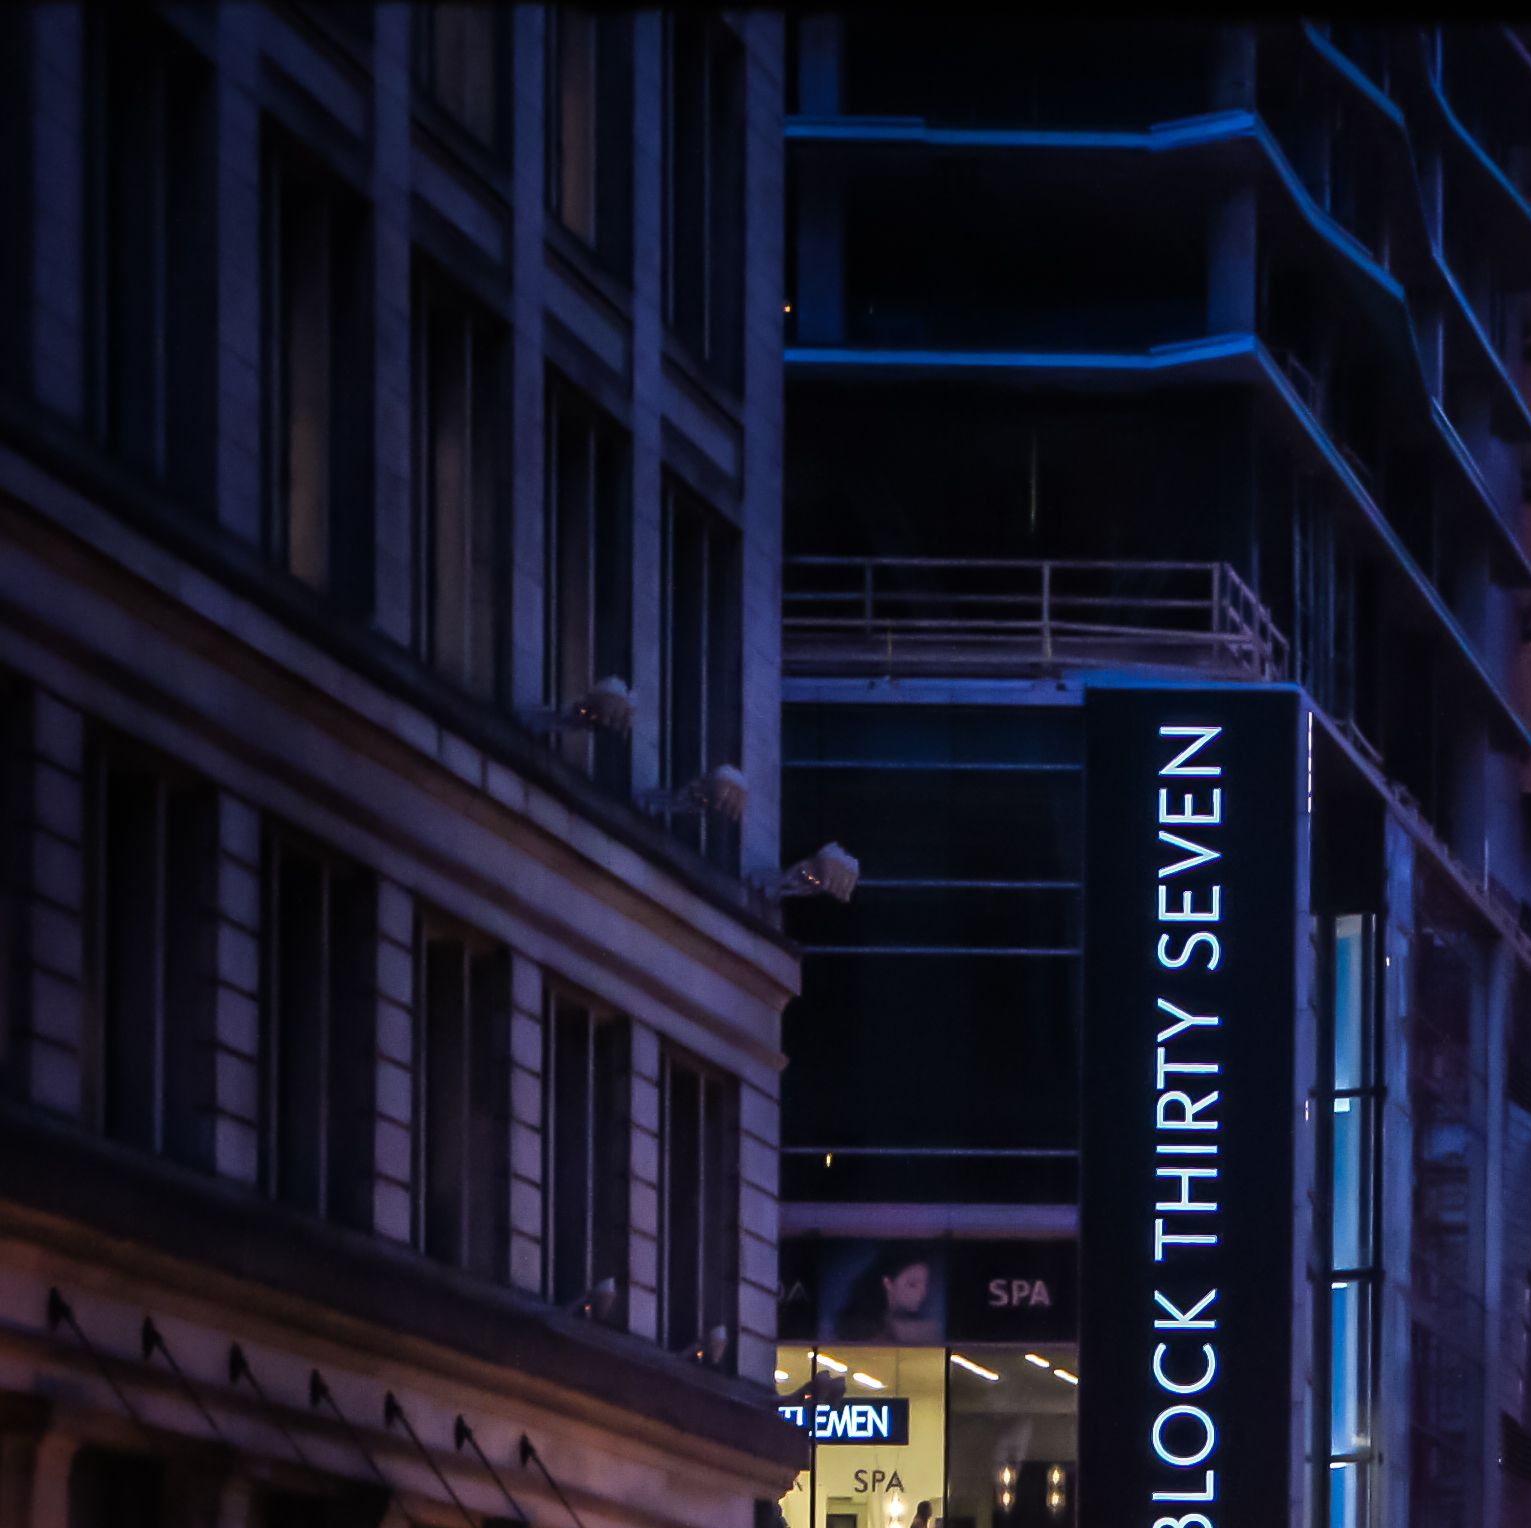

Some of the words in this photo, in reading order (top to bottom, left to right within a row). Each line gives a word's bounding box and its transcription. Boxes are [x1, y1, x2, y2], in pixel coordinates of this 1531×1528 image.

[1157, 725, 1222, 971] SEVEN
[1153, 997, 1219, 1261] THIRTY
[988, 1279, 1052, 1307] SPA
[853, 1469, 905, 1494] SPA
